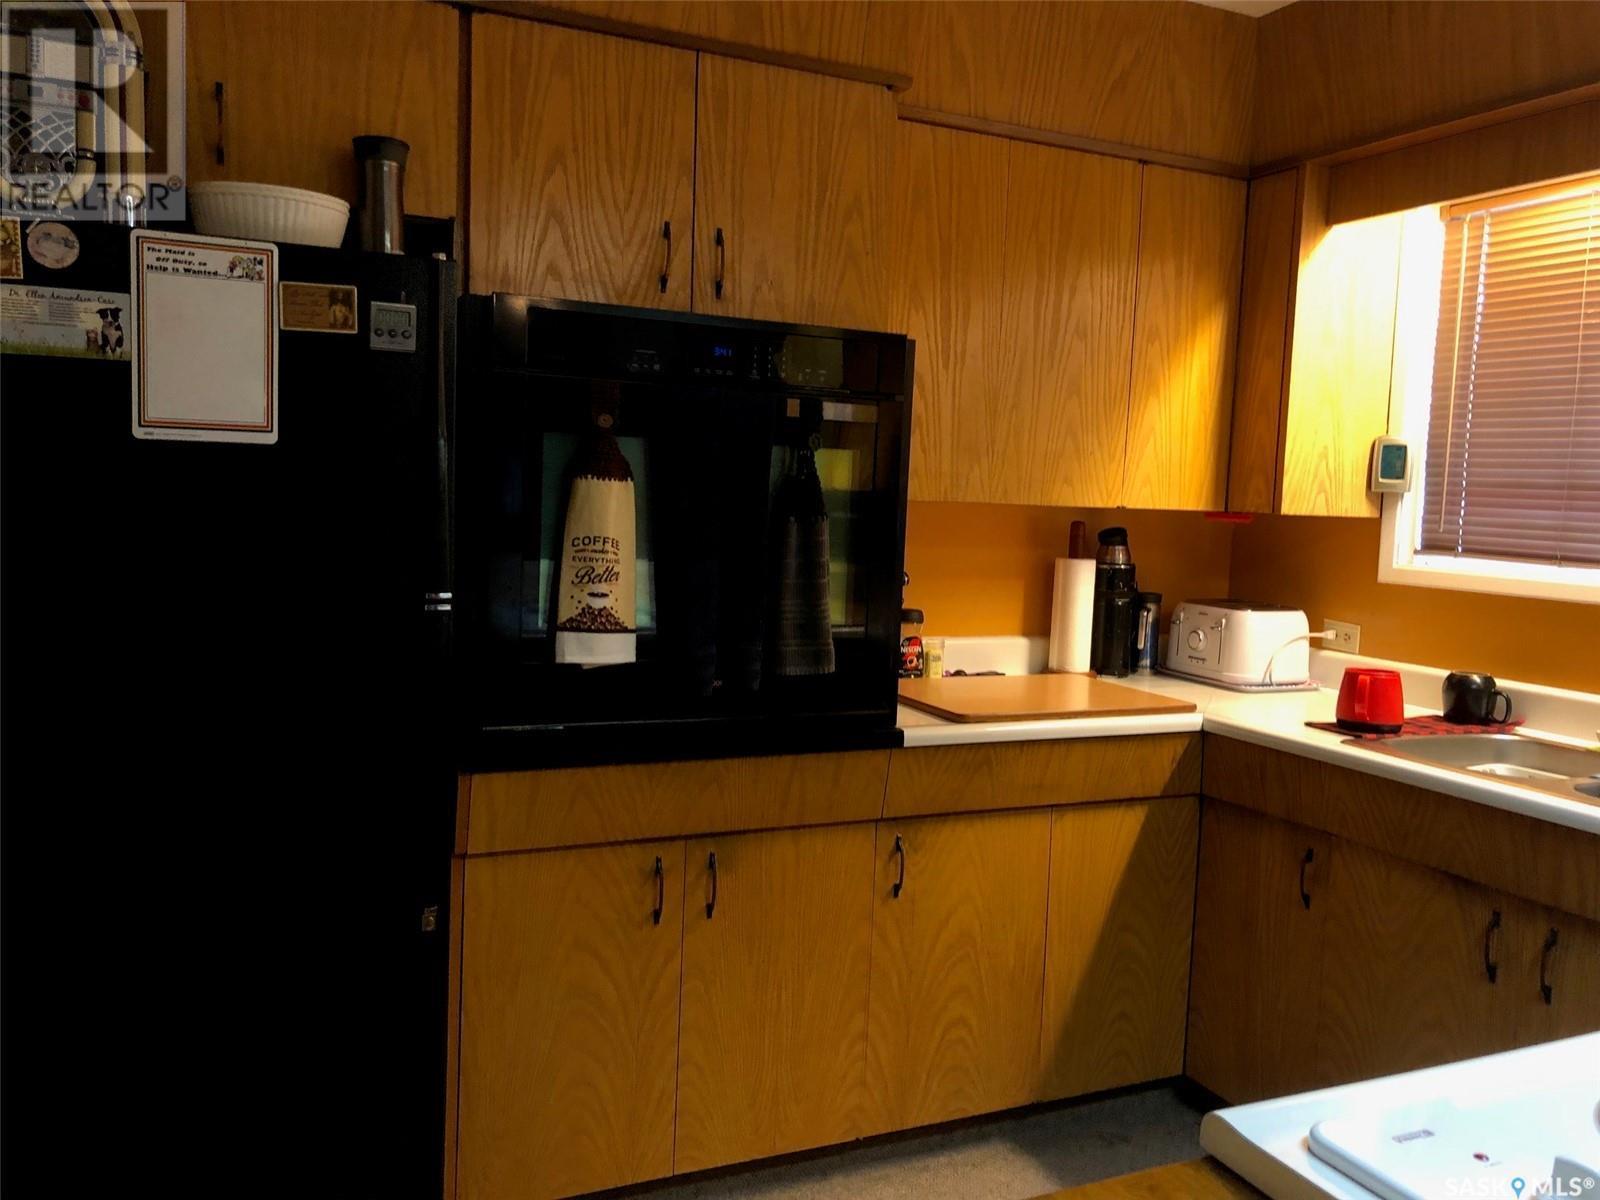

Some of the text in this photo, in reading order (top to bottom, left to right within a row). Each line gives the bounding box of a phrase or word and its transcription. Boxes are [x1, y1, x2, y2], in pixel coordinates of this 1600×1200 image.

[146, 264, 169, 273] Help
[571, 535, 620, 551] COFFEE
[571, 565, 620, 585] Better
